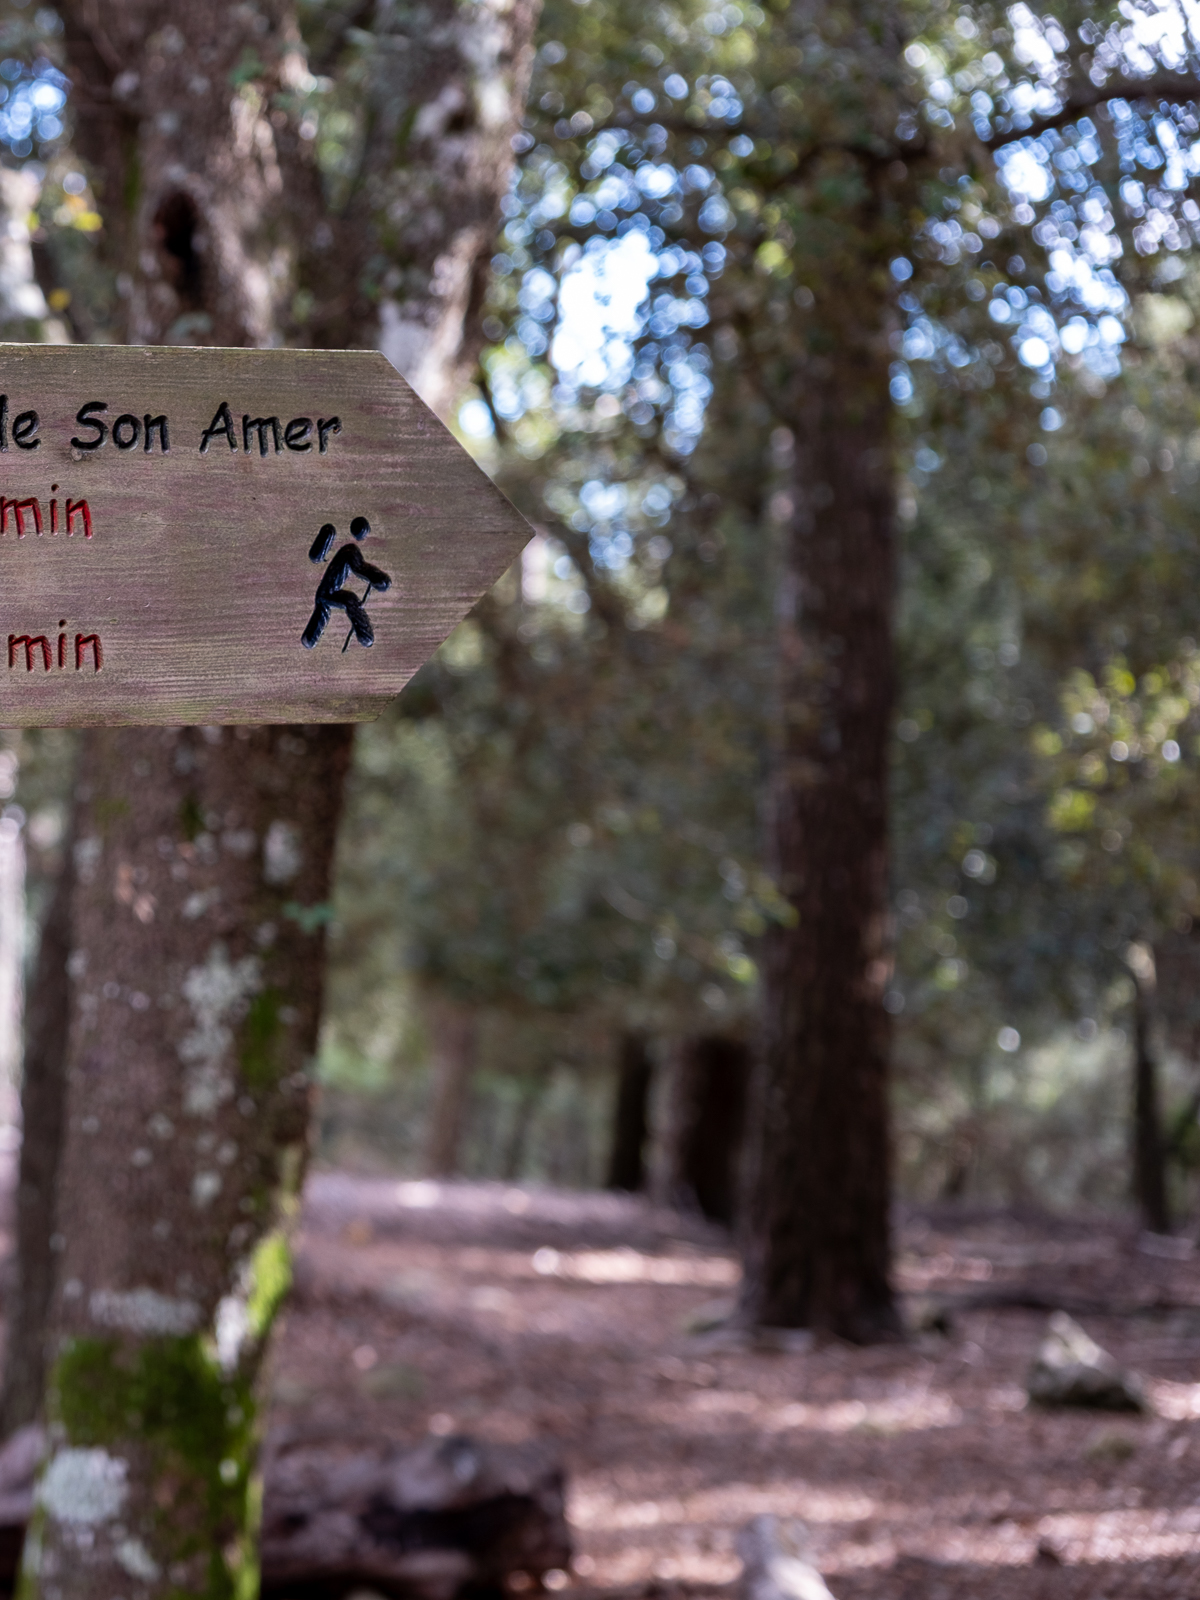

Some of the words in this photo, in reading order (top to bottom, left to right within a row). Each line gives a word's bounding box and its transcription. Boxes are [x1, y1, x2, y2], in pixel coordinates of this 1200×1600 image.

[69, 401, 170, 455] Son
[200, 401, 342, 457] Amer
[7, 619, 104, 674] min
